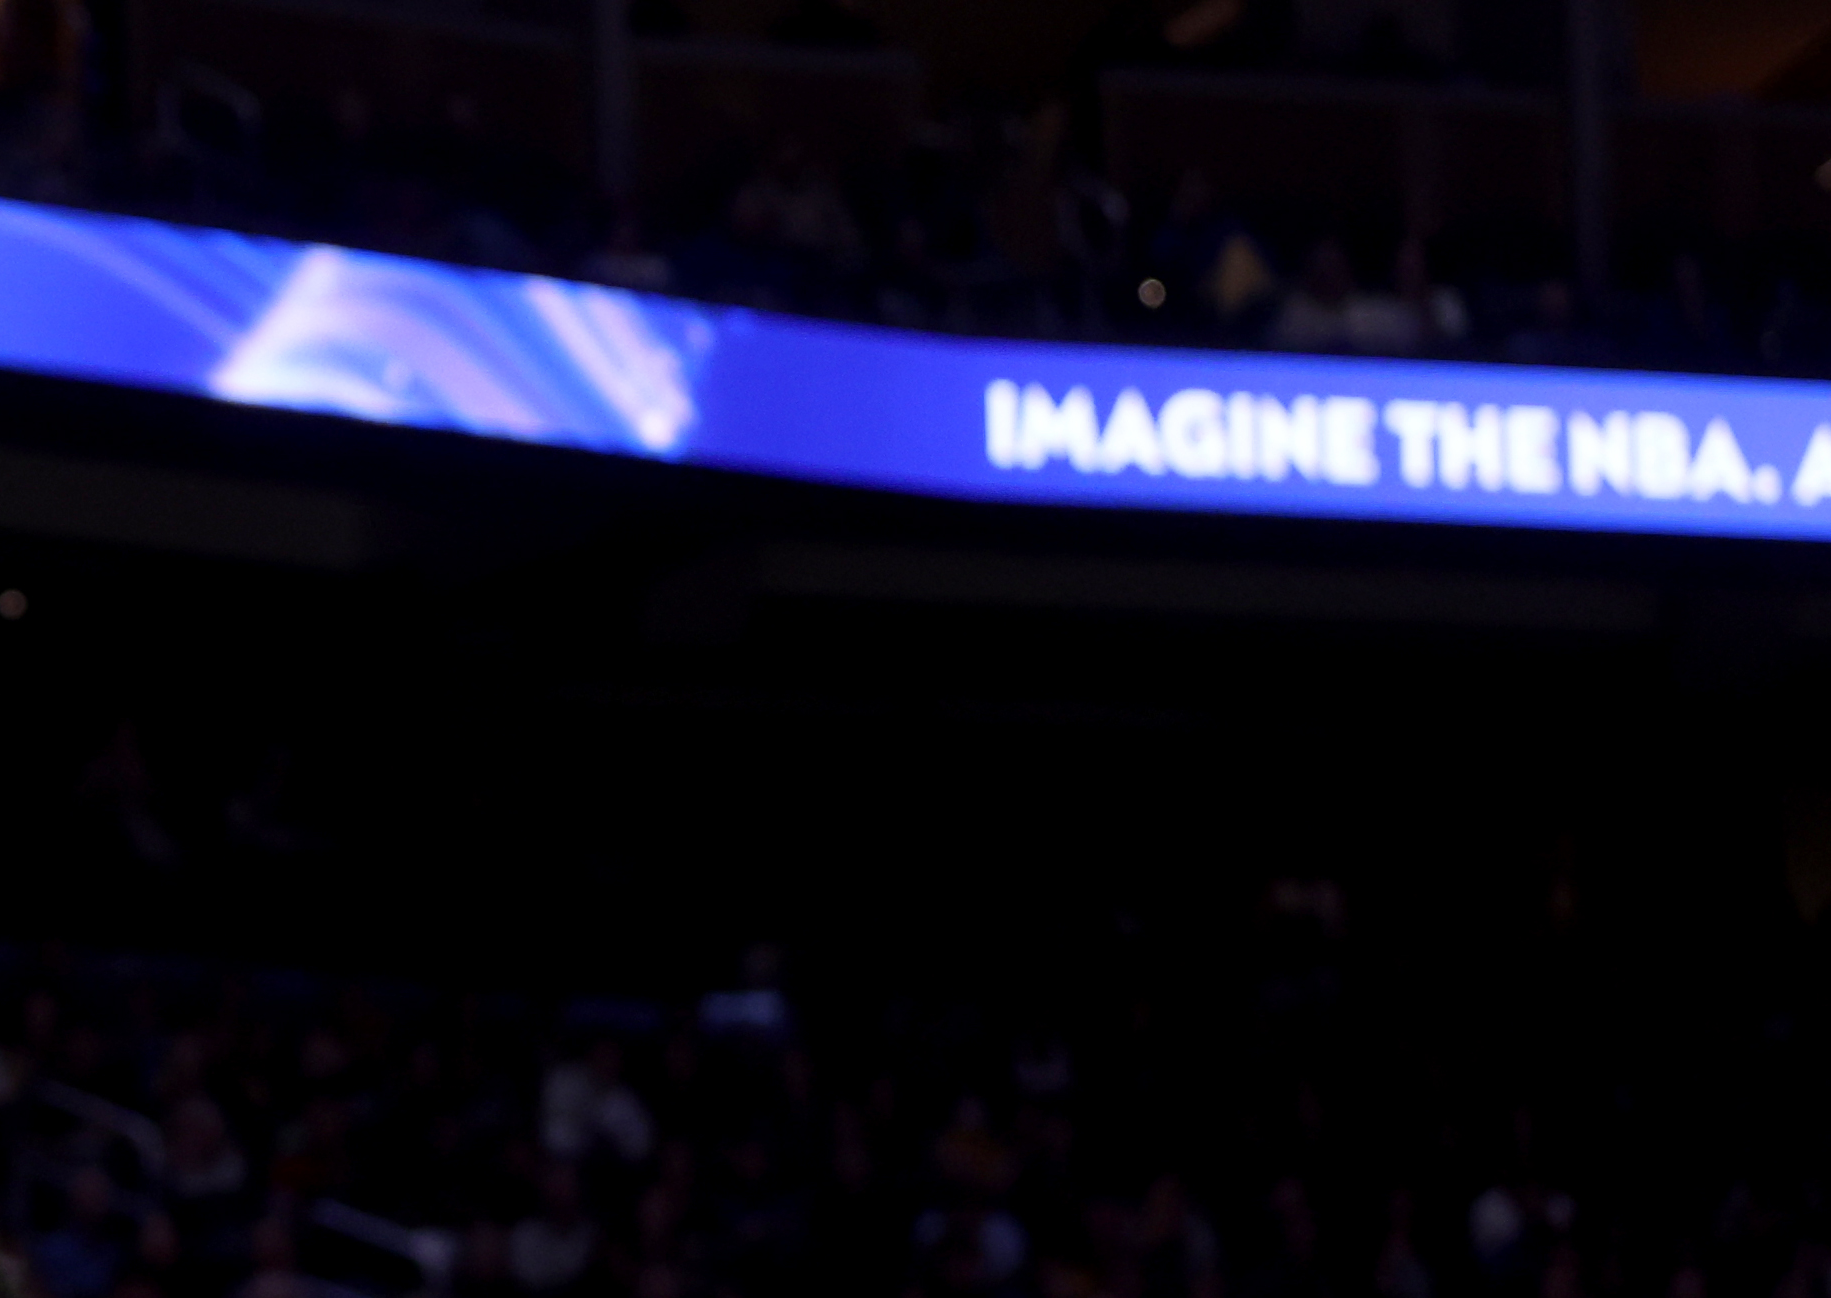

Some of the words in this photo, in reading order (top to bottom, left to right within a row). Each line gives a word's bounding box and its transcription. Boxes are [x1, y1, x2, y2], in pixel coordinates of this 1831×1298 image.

[984, 378, 1378, 485] IMAGINE
[1384, 398, 1562, 495] THE
[1566, 408, 1783, 506] NBA.
